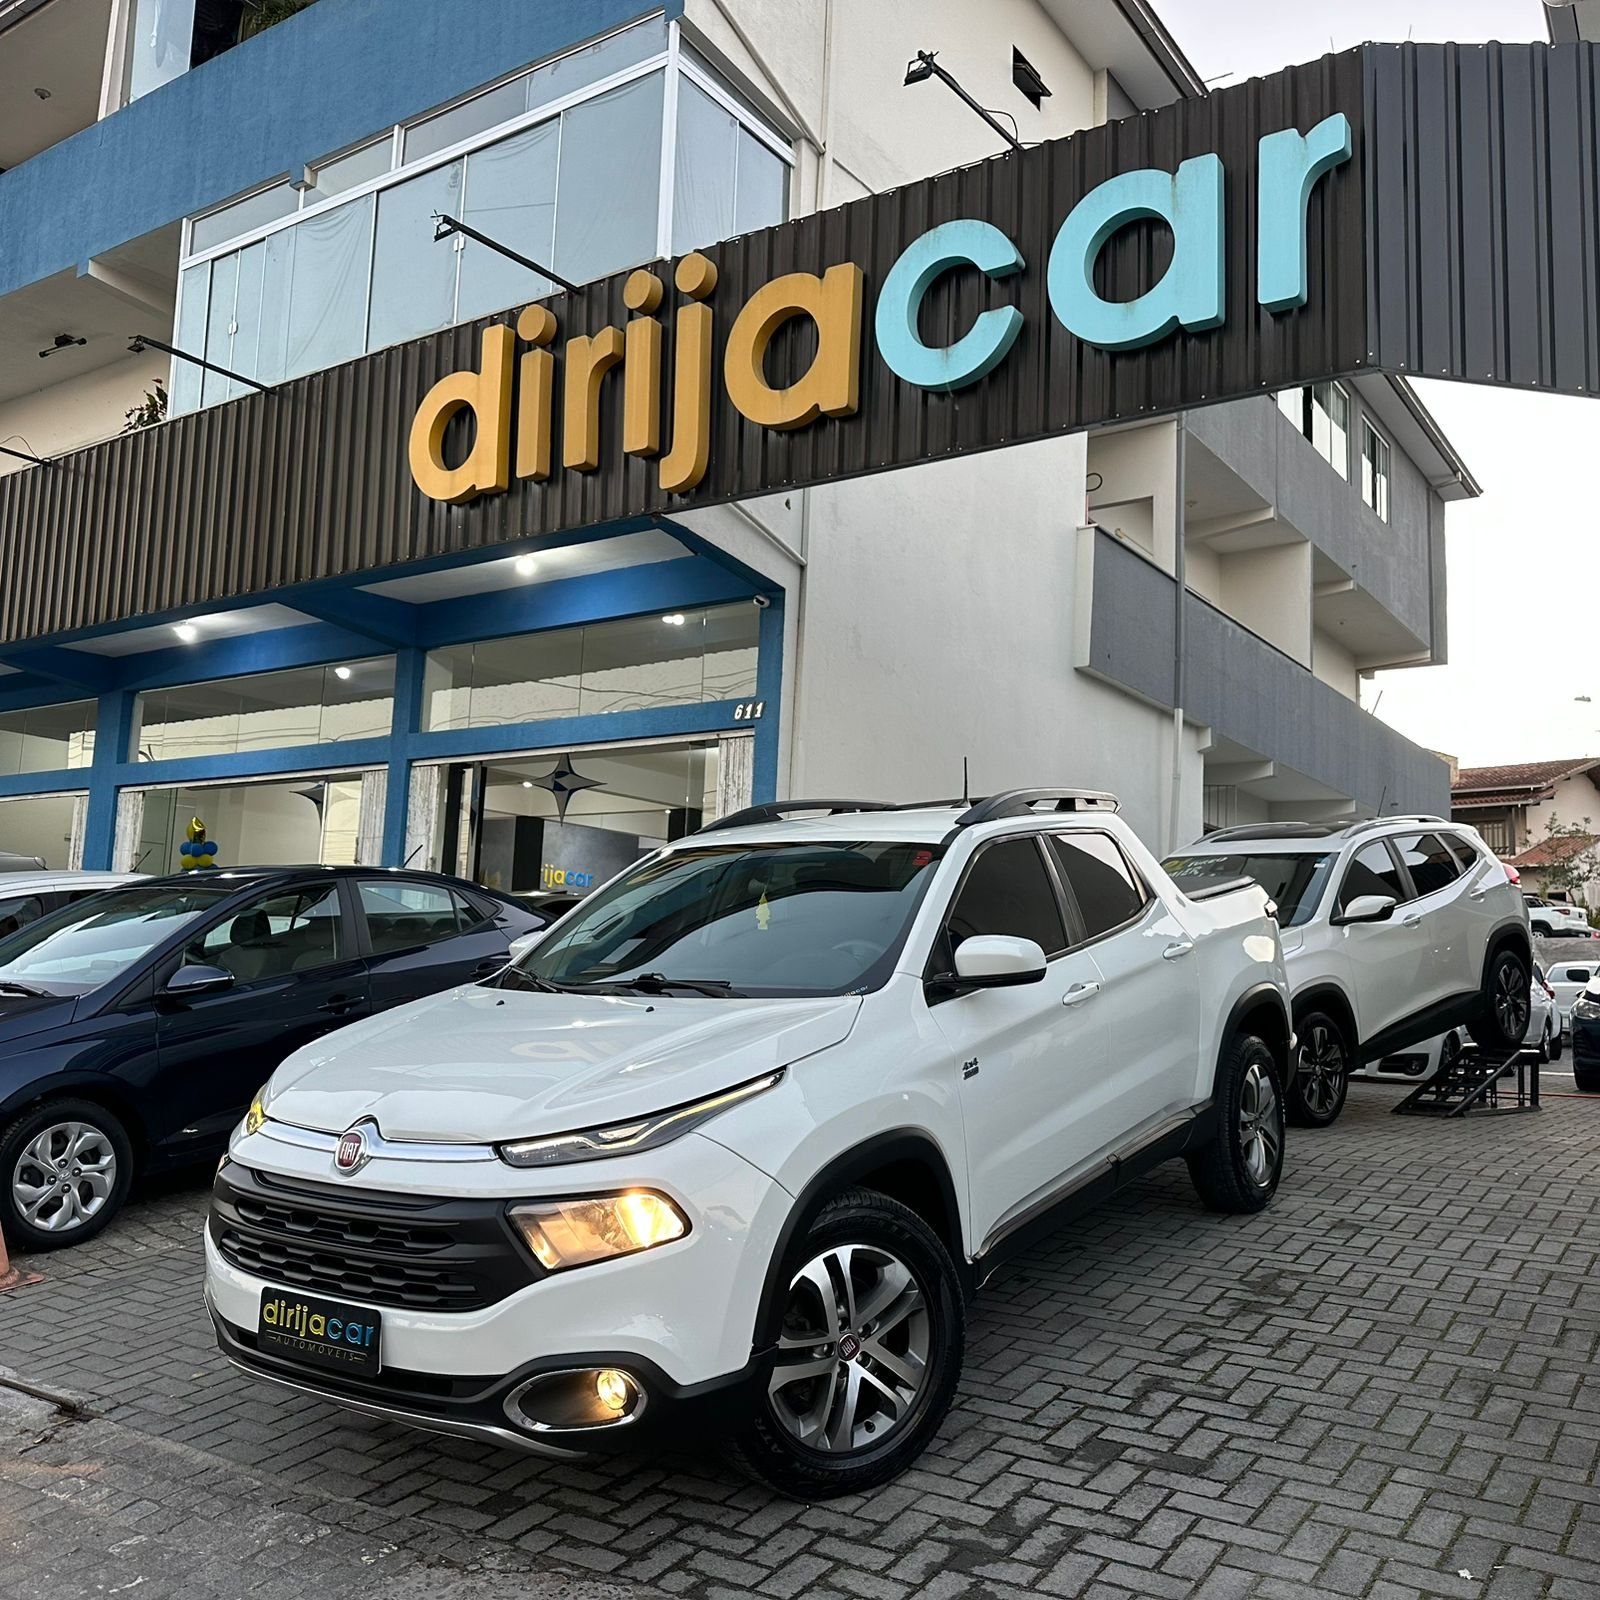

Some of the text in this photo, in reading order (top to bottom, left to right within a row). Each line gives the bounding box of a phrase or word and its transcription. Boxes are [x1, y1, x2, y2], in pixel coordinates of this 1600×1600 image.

[409, 112, 1352, 504] dirijacar
[734, 702, 763, 719] 611
[542, 863, 593, 888] ijacar
[340, 1141, 360, 1160] FIAT
[263, 1299, 374, 1347] dirijacar
[841, 1338, 856, 1356] FIAT
